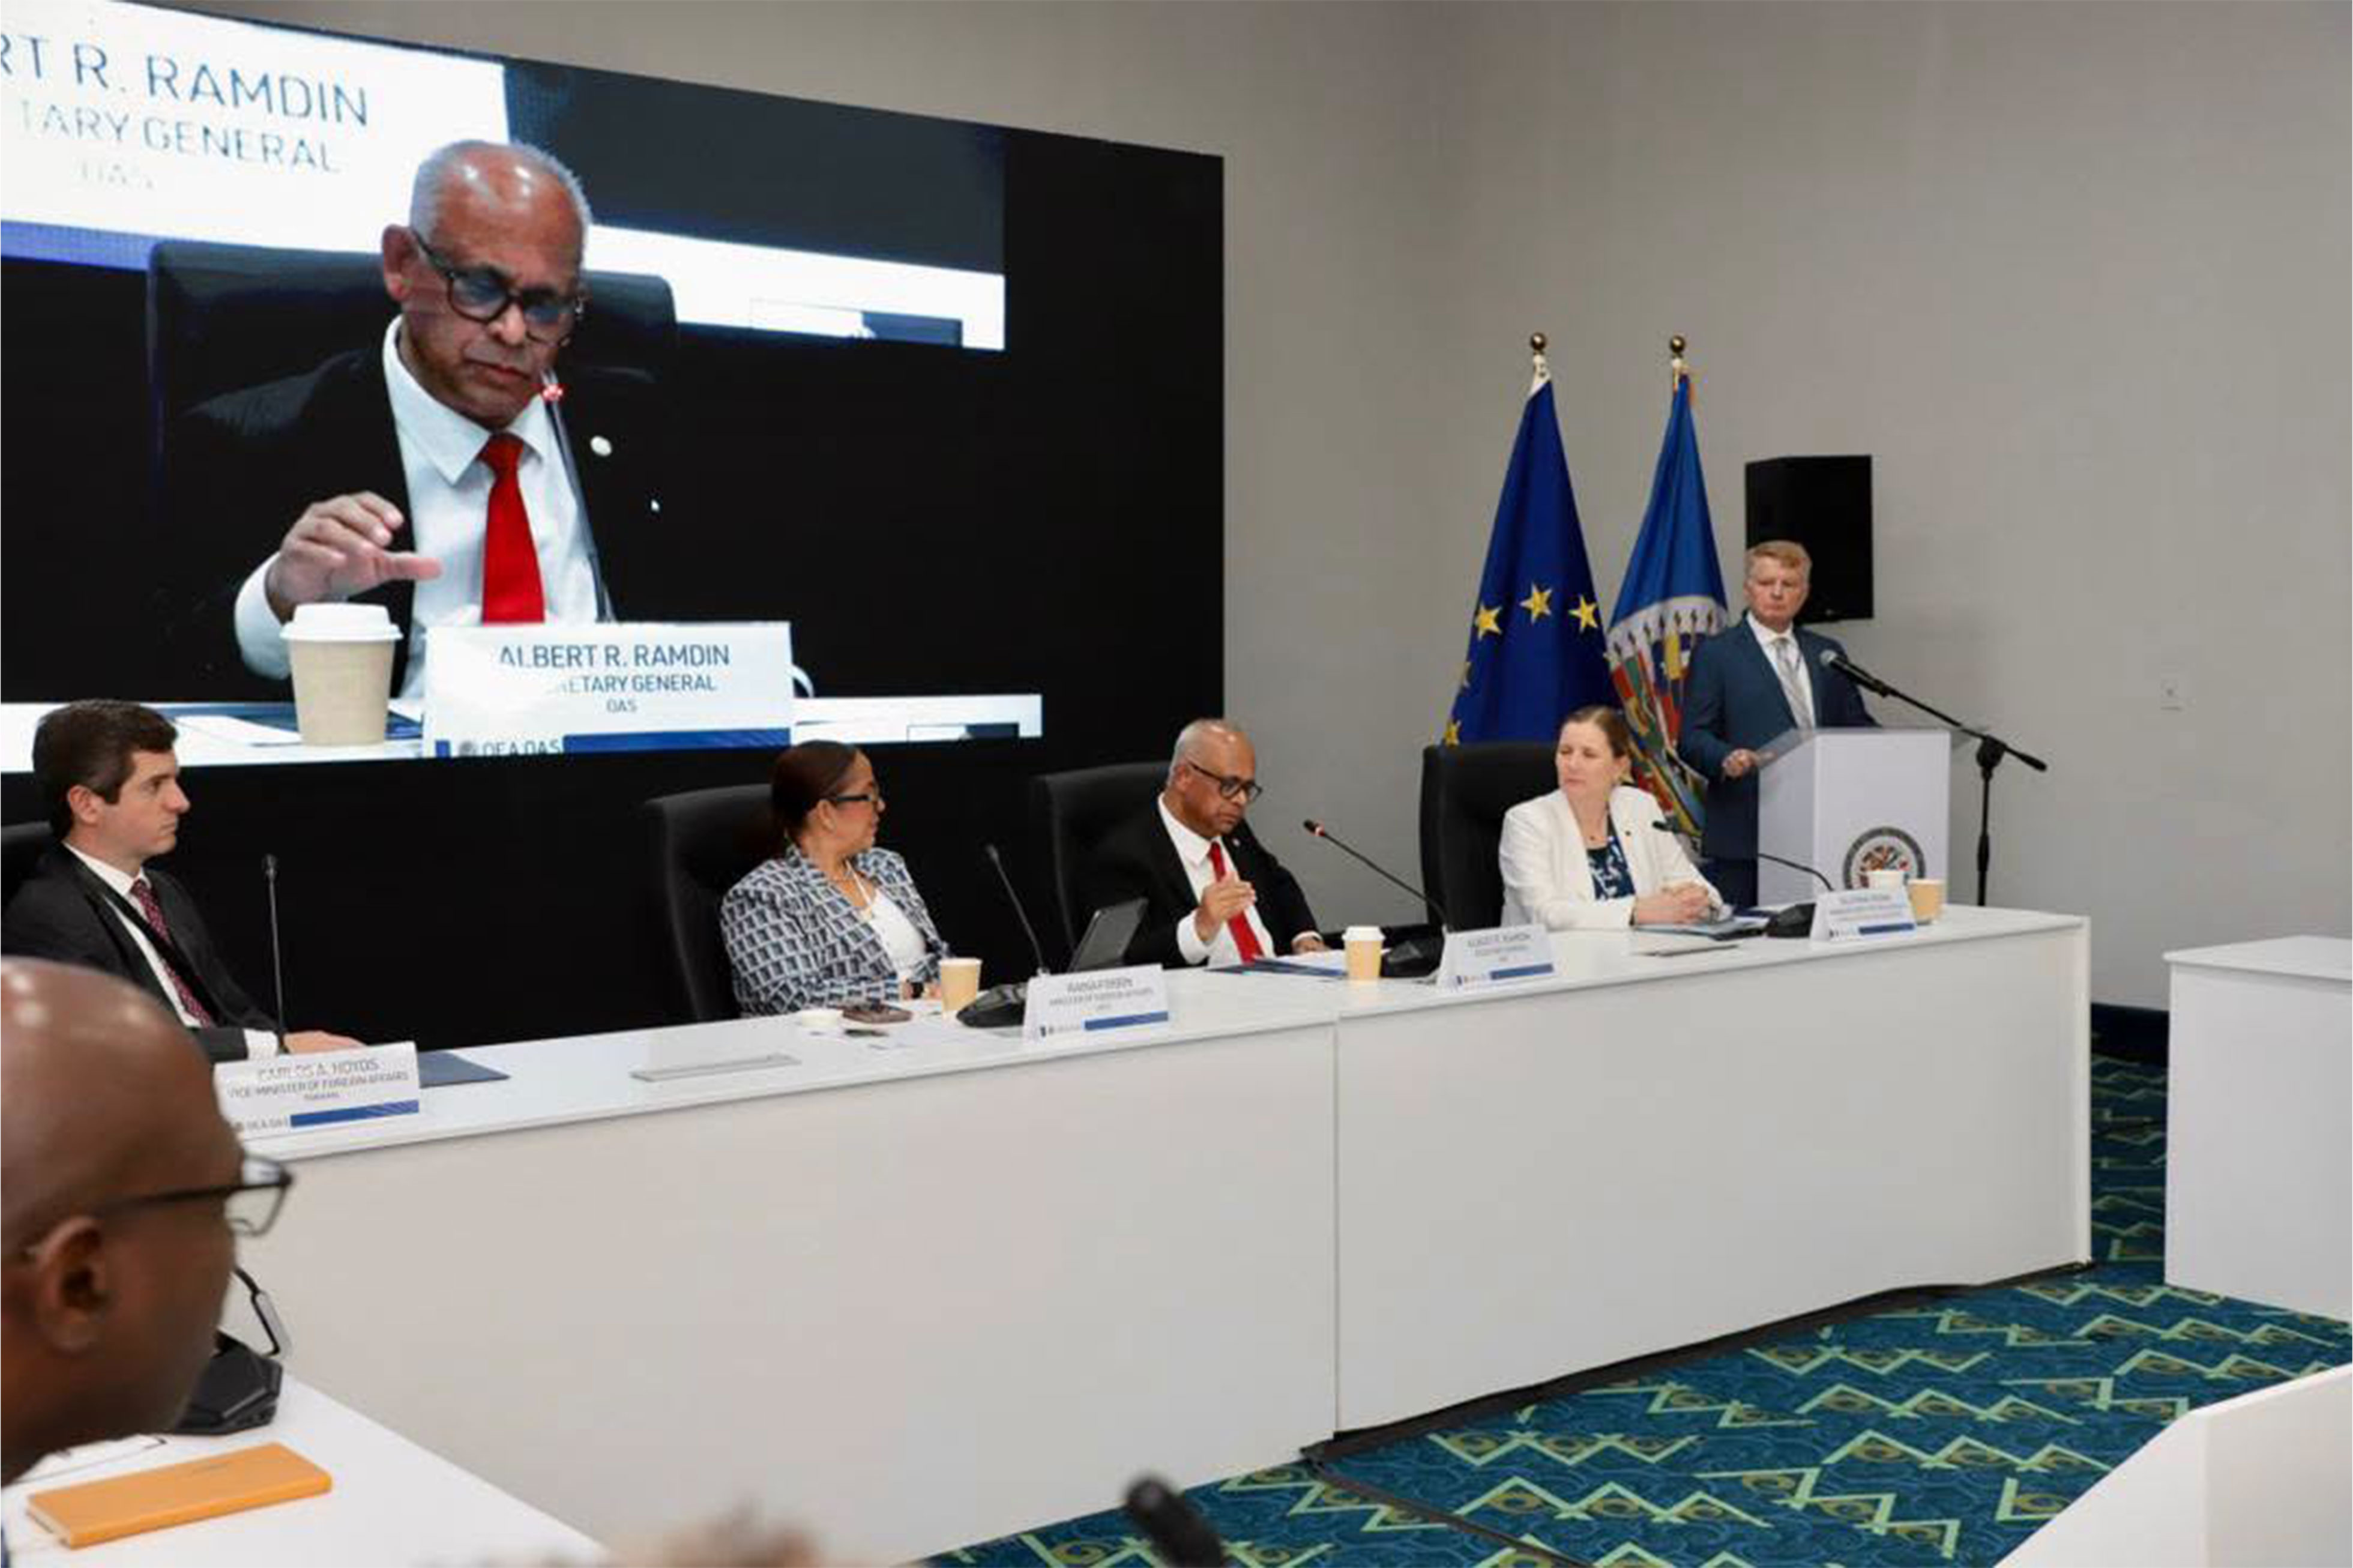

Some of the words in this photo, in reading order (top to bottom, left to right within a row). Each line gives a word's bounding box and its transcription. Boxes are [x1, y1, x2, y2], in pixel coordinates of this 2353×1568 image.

[73, 43, 126, 94] R.
[147, 55, 368, 126] RAMDIN
[143, 116, 340, 172] GENERAL
[501, 645, 597, 668] ALBERT
[604, 645, 628, 667] R.
[634, 644, 730, 667] RAMDIN
[631, 674, 717, 693] GENERAL
[606, 697, 638, 713] OAS
